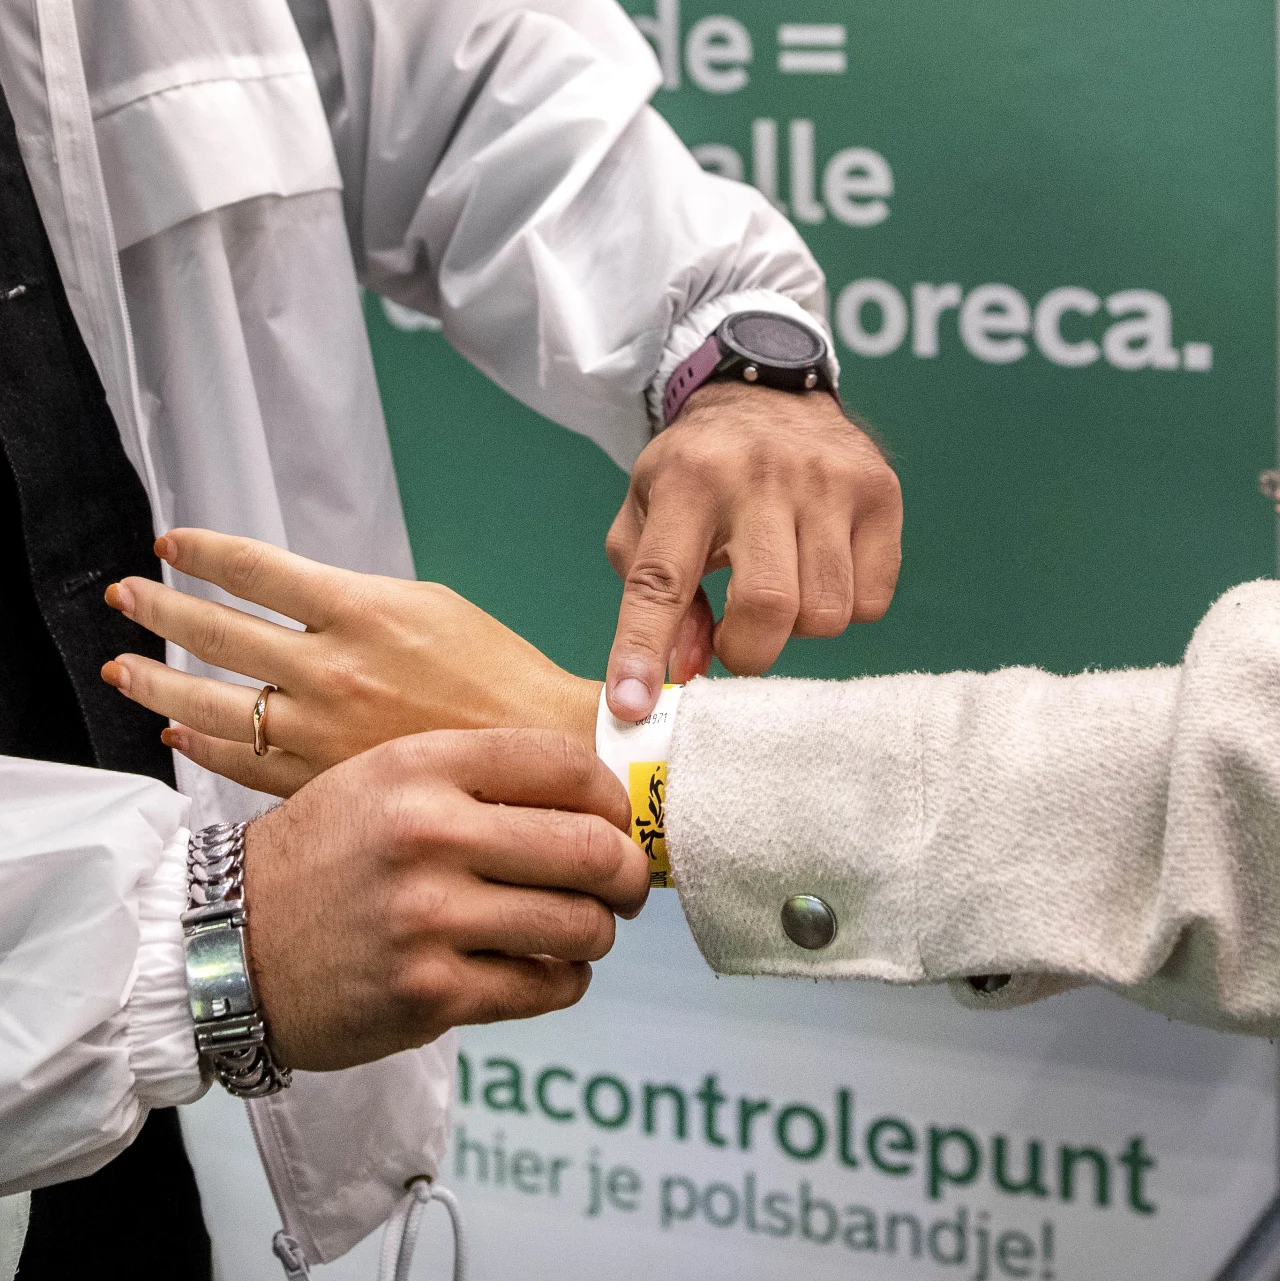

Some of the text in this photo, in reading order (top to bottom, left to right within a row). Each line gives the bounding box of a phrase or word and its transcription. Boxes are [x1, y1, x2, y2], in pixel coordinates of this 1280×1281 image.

[777, 22, 848, 73] =
[826, 276, 1216, 373] oreca.
[454, 1123, 1057, 1281] hier je polsbandje!
